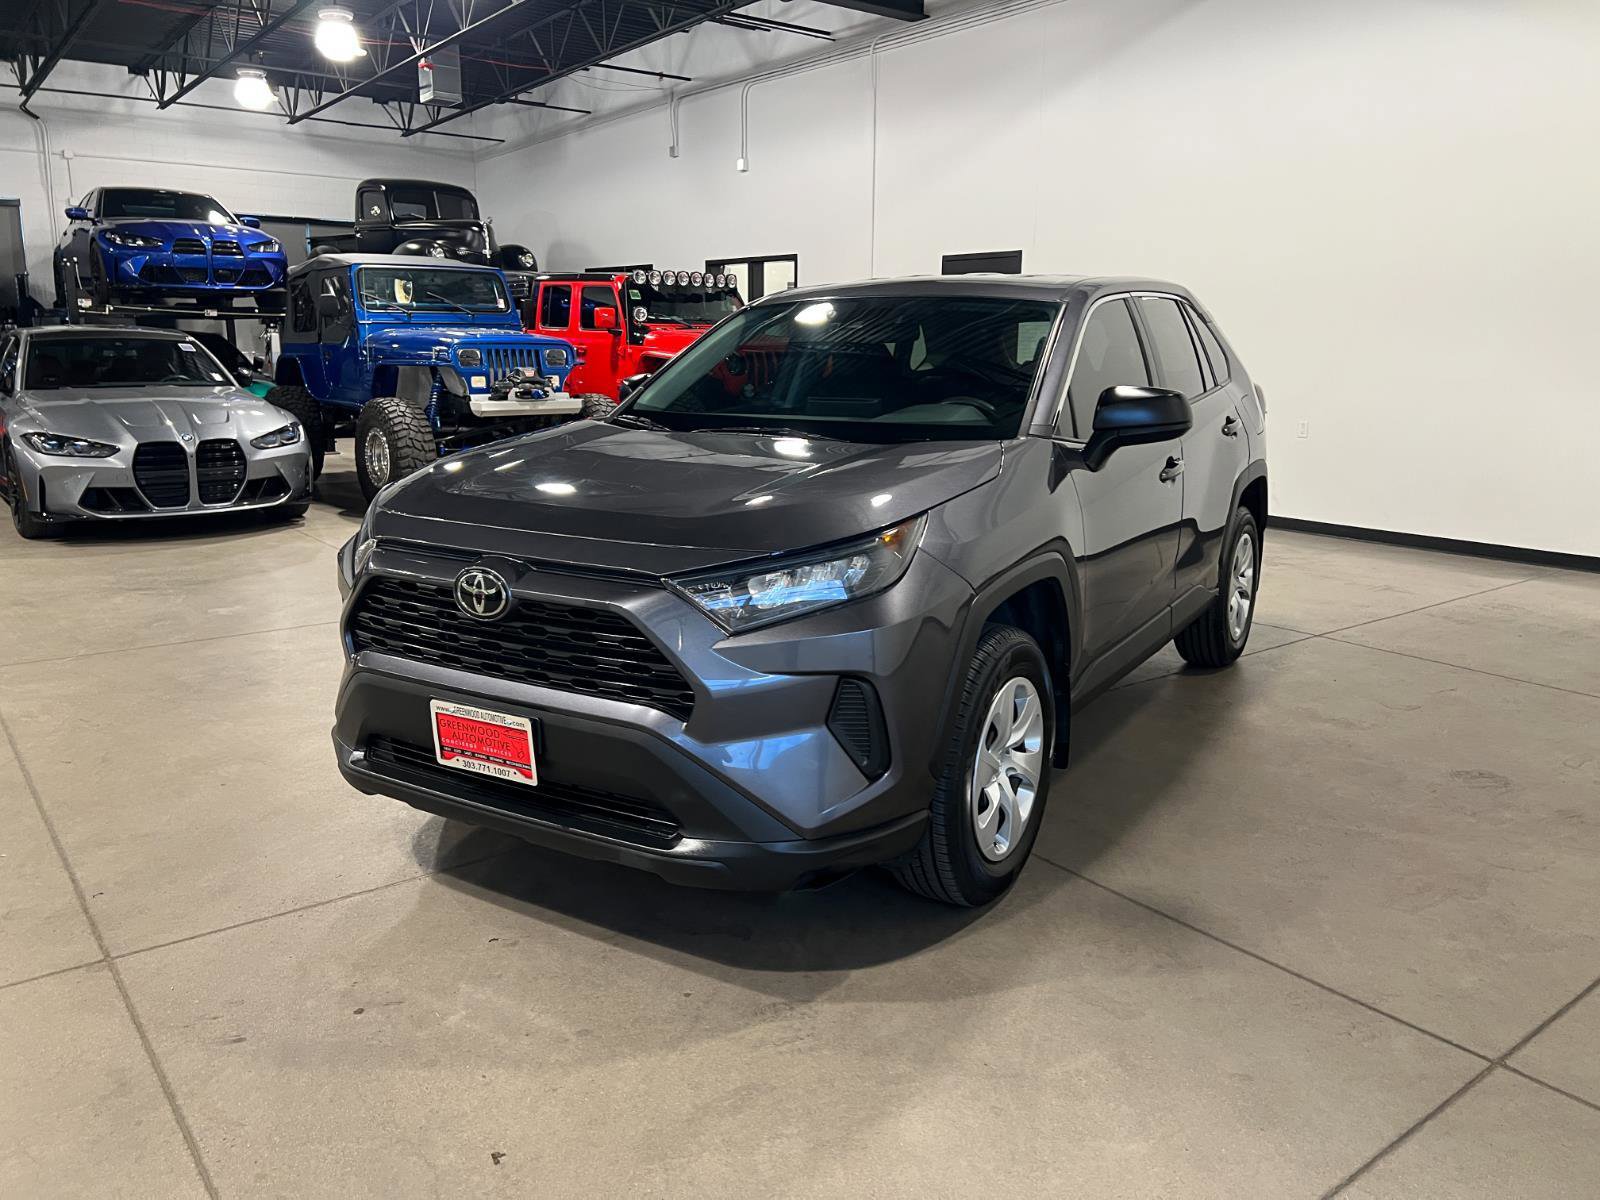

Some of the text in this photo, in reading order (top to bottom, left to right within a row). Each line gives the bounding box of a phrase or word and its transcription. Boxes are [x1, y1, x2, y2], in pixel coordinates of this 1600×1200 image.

[440, 718, 500, 739] GREENWOOD
[452, 731, 511, 751] AUTOMOTIVE
[482, 746, 512, 757] SERVICES
[462, 759, 511, 778] 303.771.1007
